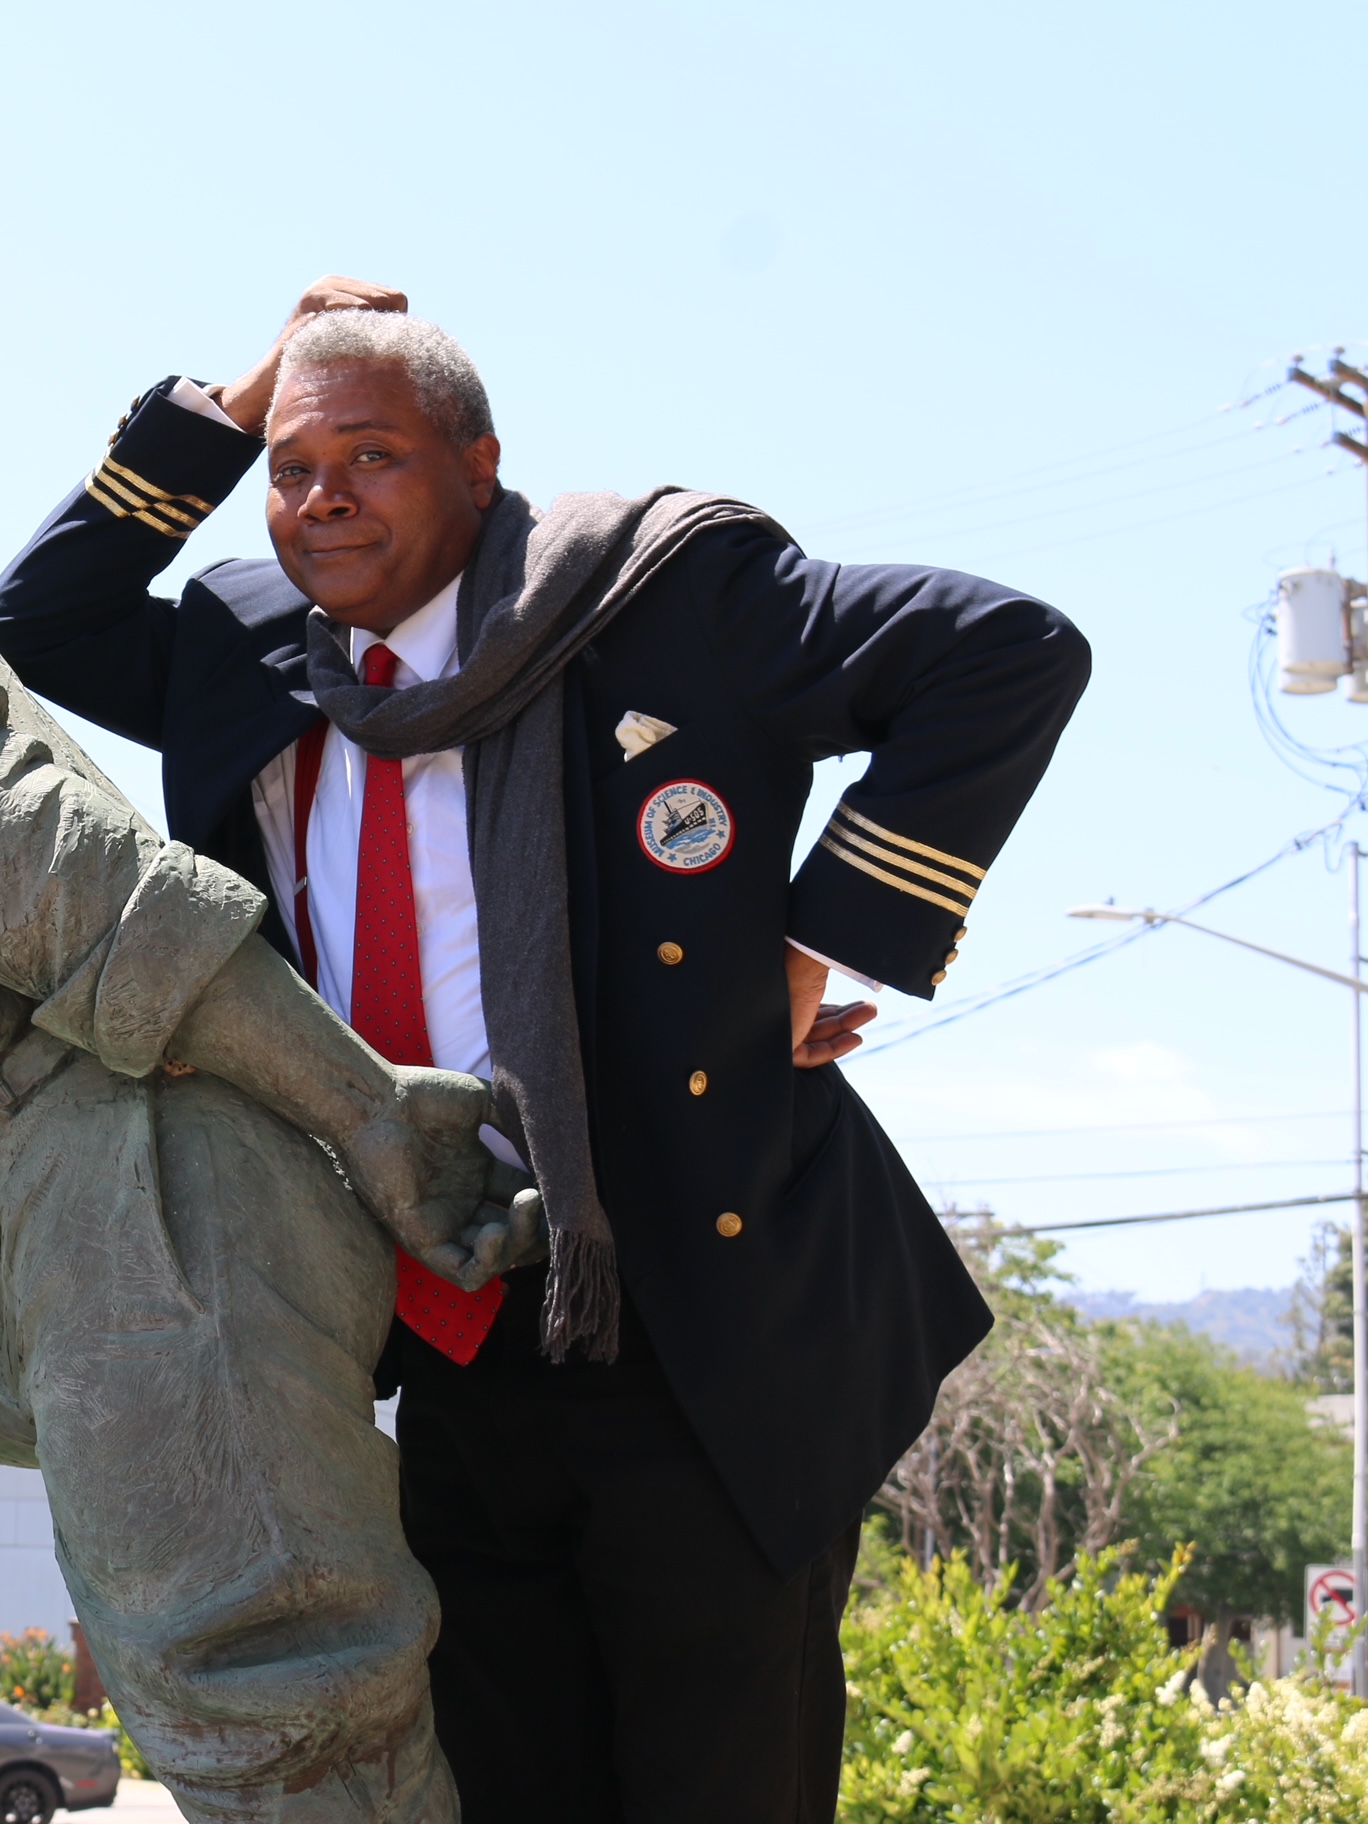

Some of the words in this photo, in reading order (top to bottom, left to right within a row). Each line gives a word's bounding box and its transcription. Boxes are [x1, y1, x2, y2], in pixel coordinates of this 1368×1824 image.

[653, 786, 687, 807] SCIENCE
[696, 789, 727, 827] INDUSTRY
[646, 806, 656, 818] OF
[644, 821, 665, 857] MUSEUM
[683, 843, 721, 866] CHICAGO
